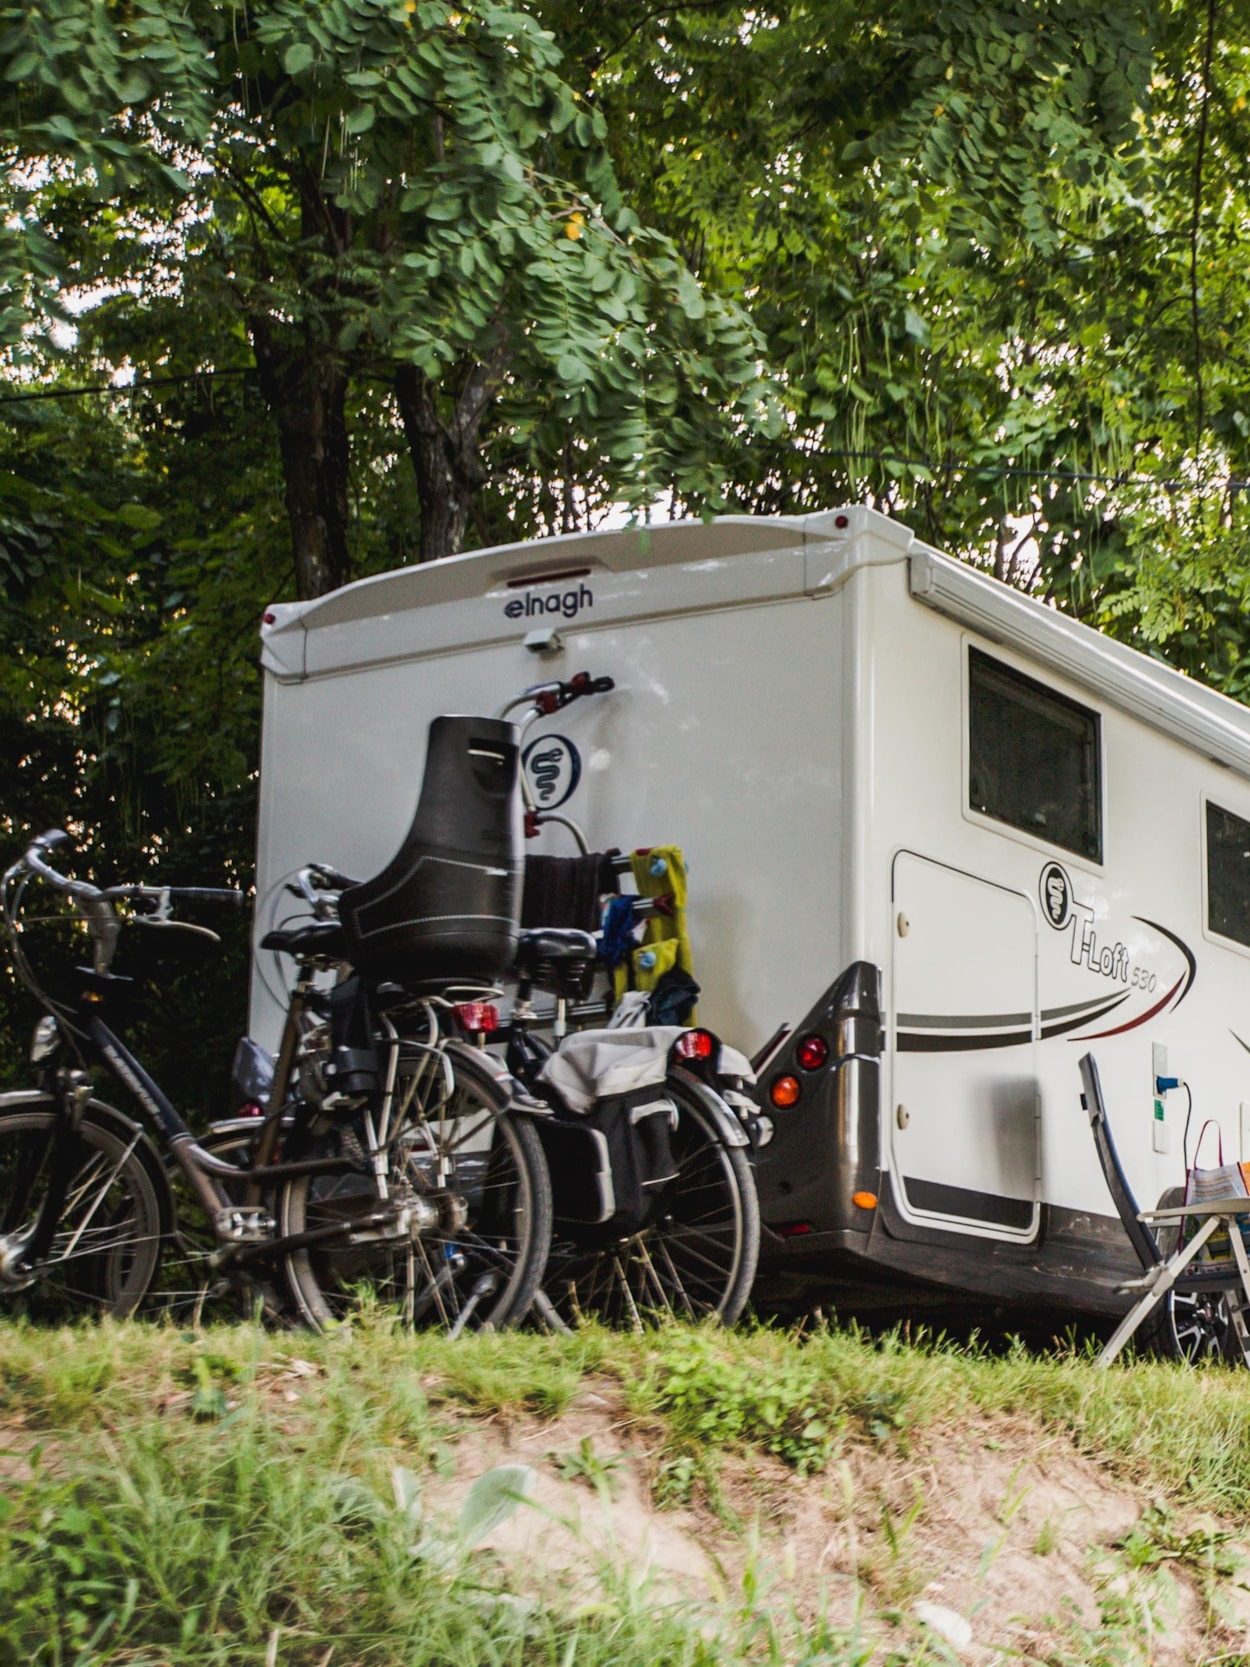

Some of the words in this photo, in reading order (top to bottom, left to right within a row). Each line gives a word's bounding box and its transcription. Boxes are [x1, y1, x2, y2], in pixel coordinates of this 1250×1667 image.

[504, 584, 593, 618] elnagh
[1071, 901, 1129, 983] T-Loft
[1131, 966, 1157, 993] 530
